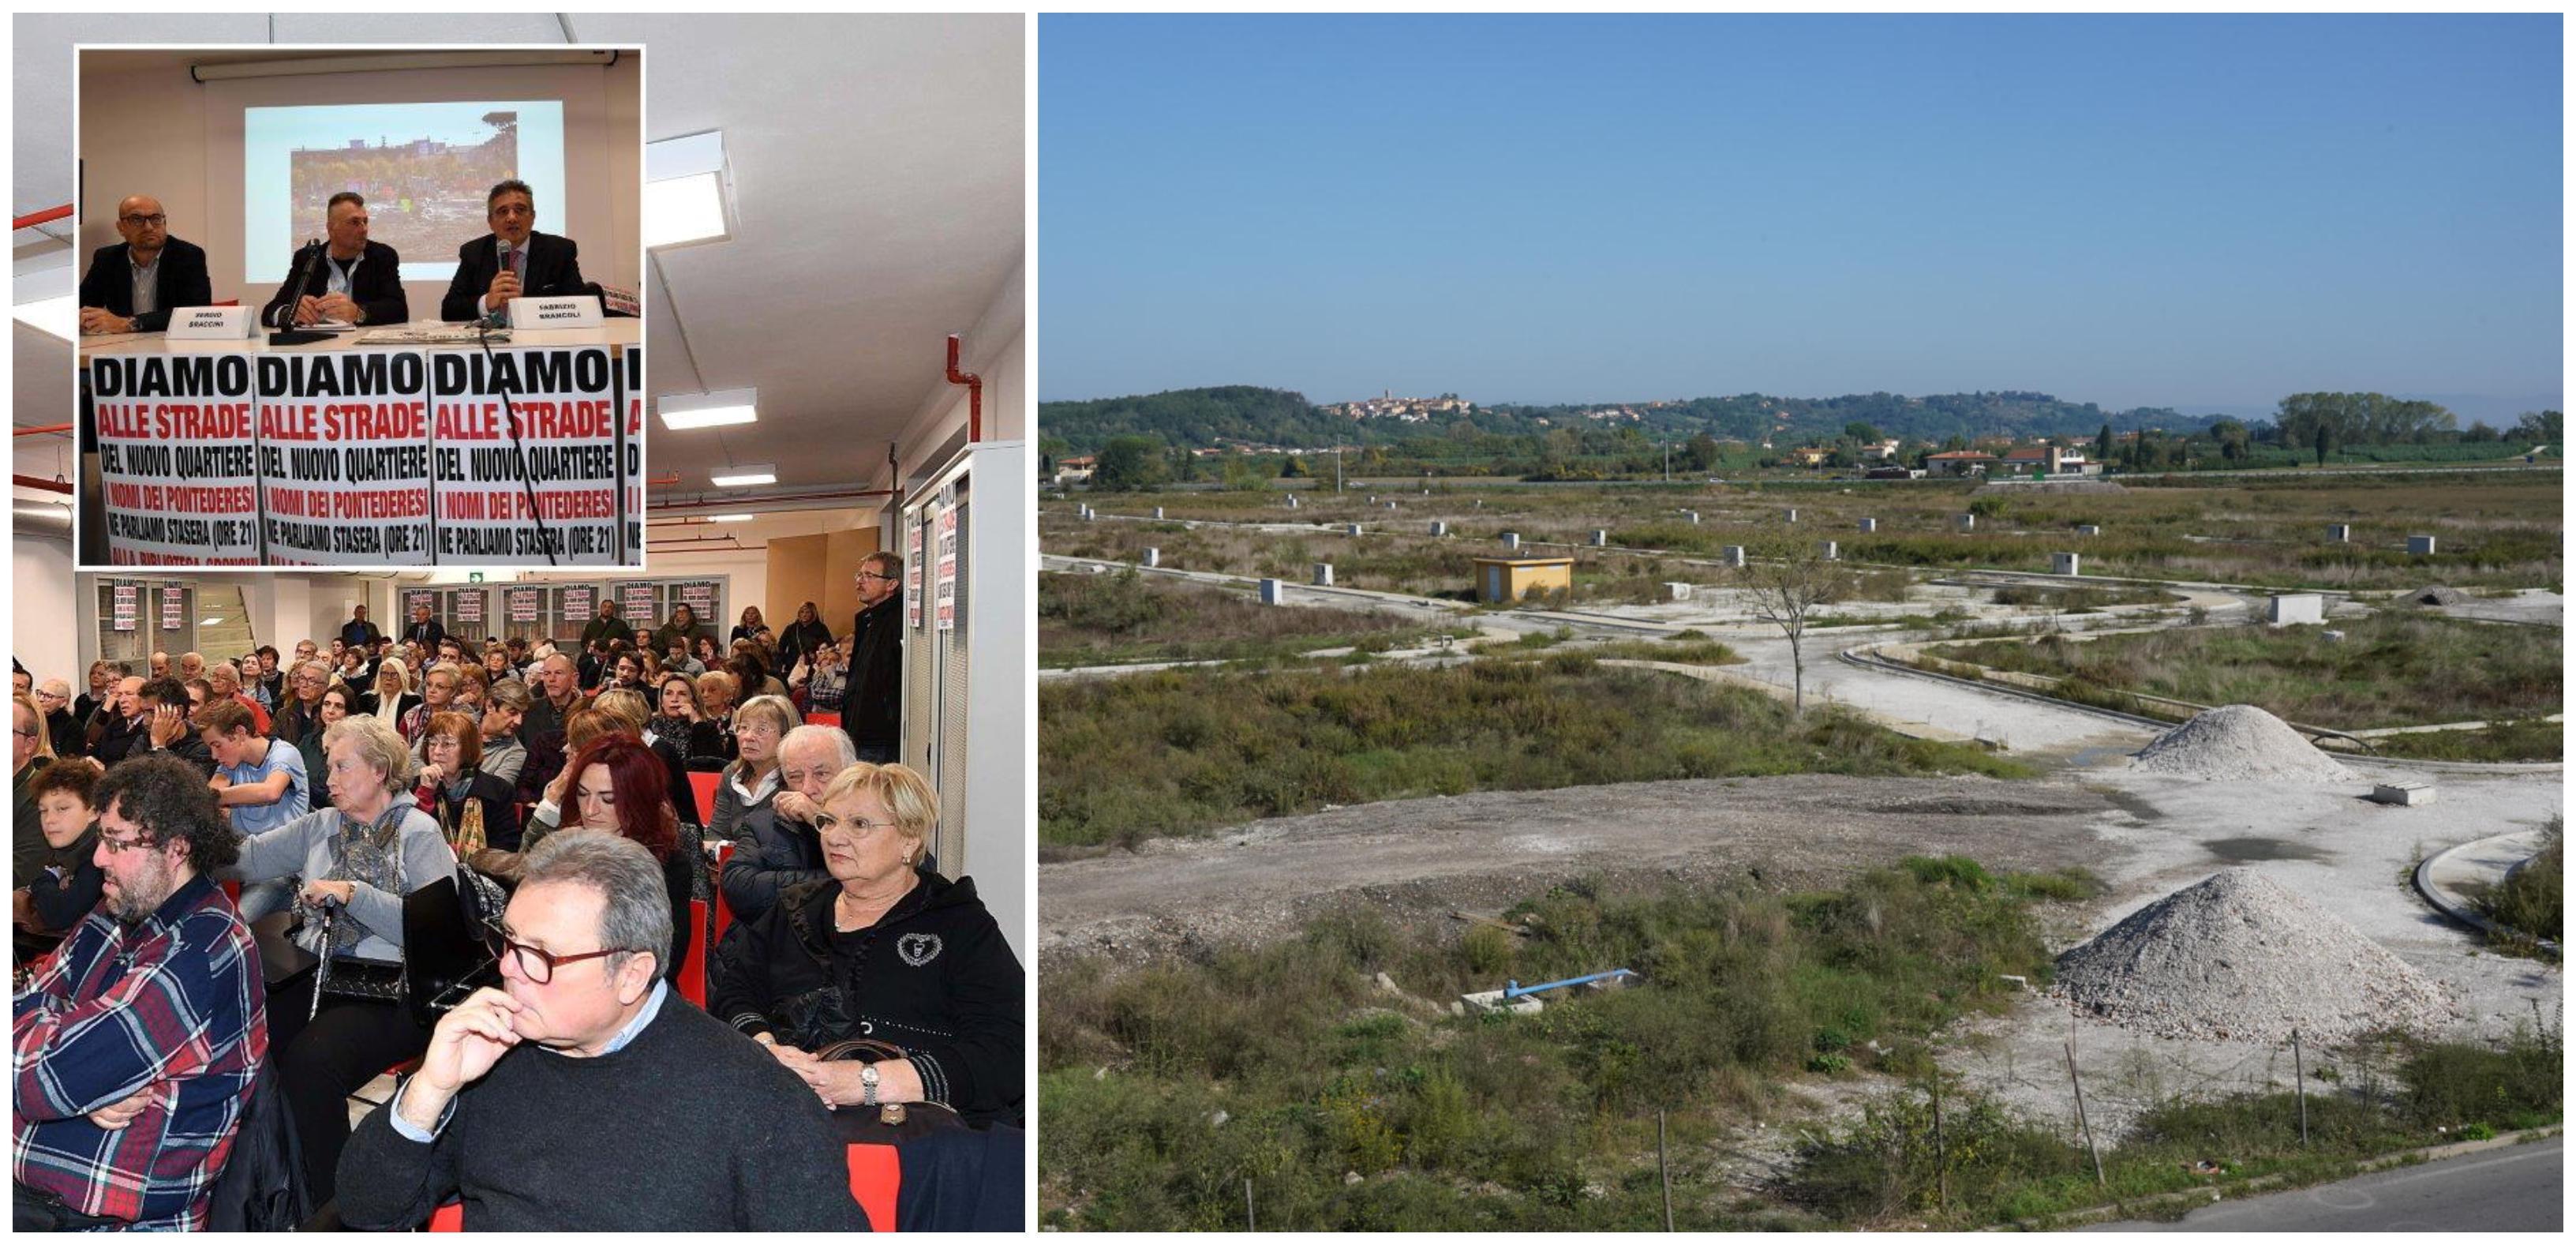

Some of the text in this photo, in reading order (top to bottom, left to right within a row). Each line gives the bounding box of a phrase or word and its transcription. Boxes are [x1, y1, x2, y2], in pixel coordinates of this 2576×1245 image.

[94, 355, 249, 397] DIAMO
[258, 352, 424, 397] DIAMO
[434, 349, 608, 395] DIAMO
[99, 403, 252, 440] ALLE STRADE
[260, 402, 426, 441] ALLE STRADE
[435, 400, 612, 440] ALLE STRADE
[100, 444, 253, 480] DEL NUOVO QUARTIERE
[261, 444, 428, 486] DEL NUOVO QUARTIERE
[436, 444, 614, 485] DEL NUOVO QUARTIERE
[111, 482, 140, 510] NOMI
[144, 485, 163, 512] DEI
[167, 486, 255, 513] PONTEDERESI
[271, 487, 304, 515] NOMI
[308, 490, 330, 518] DEI
[334, 488, 429, 519] PONTEDERESI
[447, 491, 485, 520] NOMI
[489, 492, 512, 520] DEI
[516, 489, 615, 520] PONTEDERESI
[107, 512, 257, 551] NE PARLIAMO STASERA (ORE 21)
[266, 518, 429, 559] NE PARLIAMO STASERA (ORE 21)
[438, 525, 616, 561] NE PARLIAMO STASERA (ORE 21)
